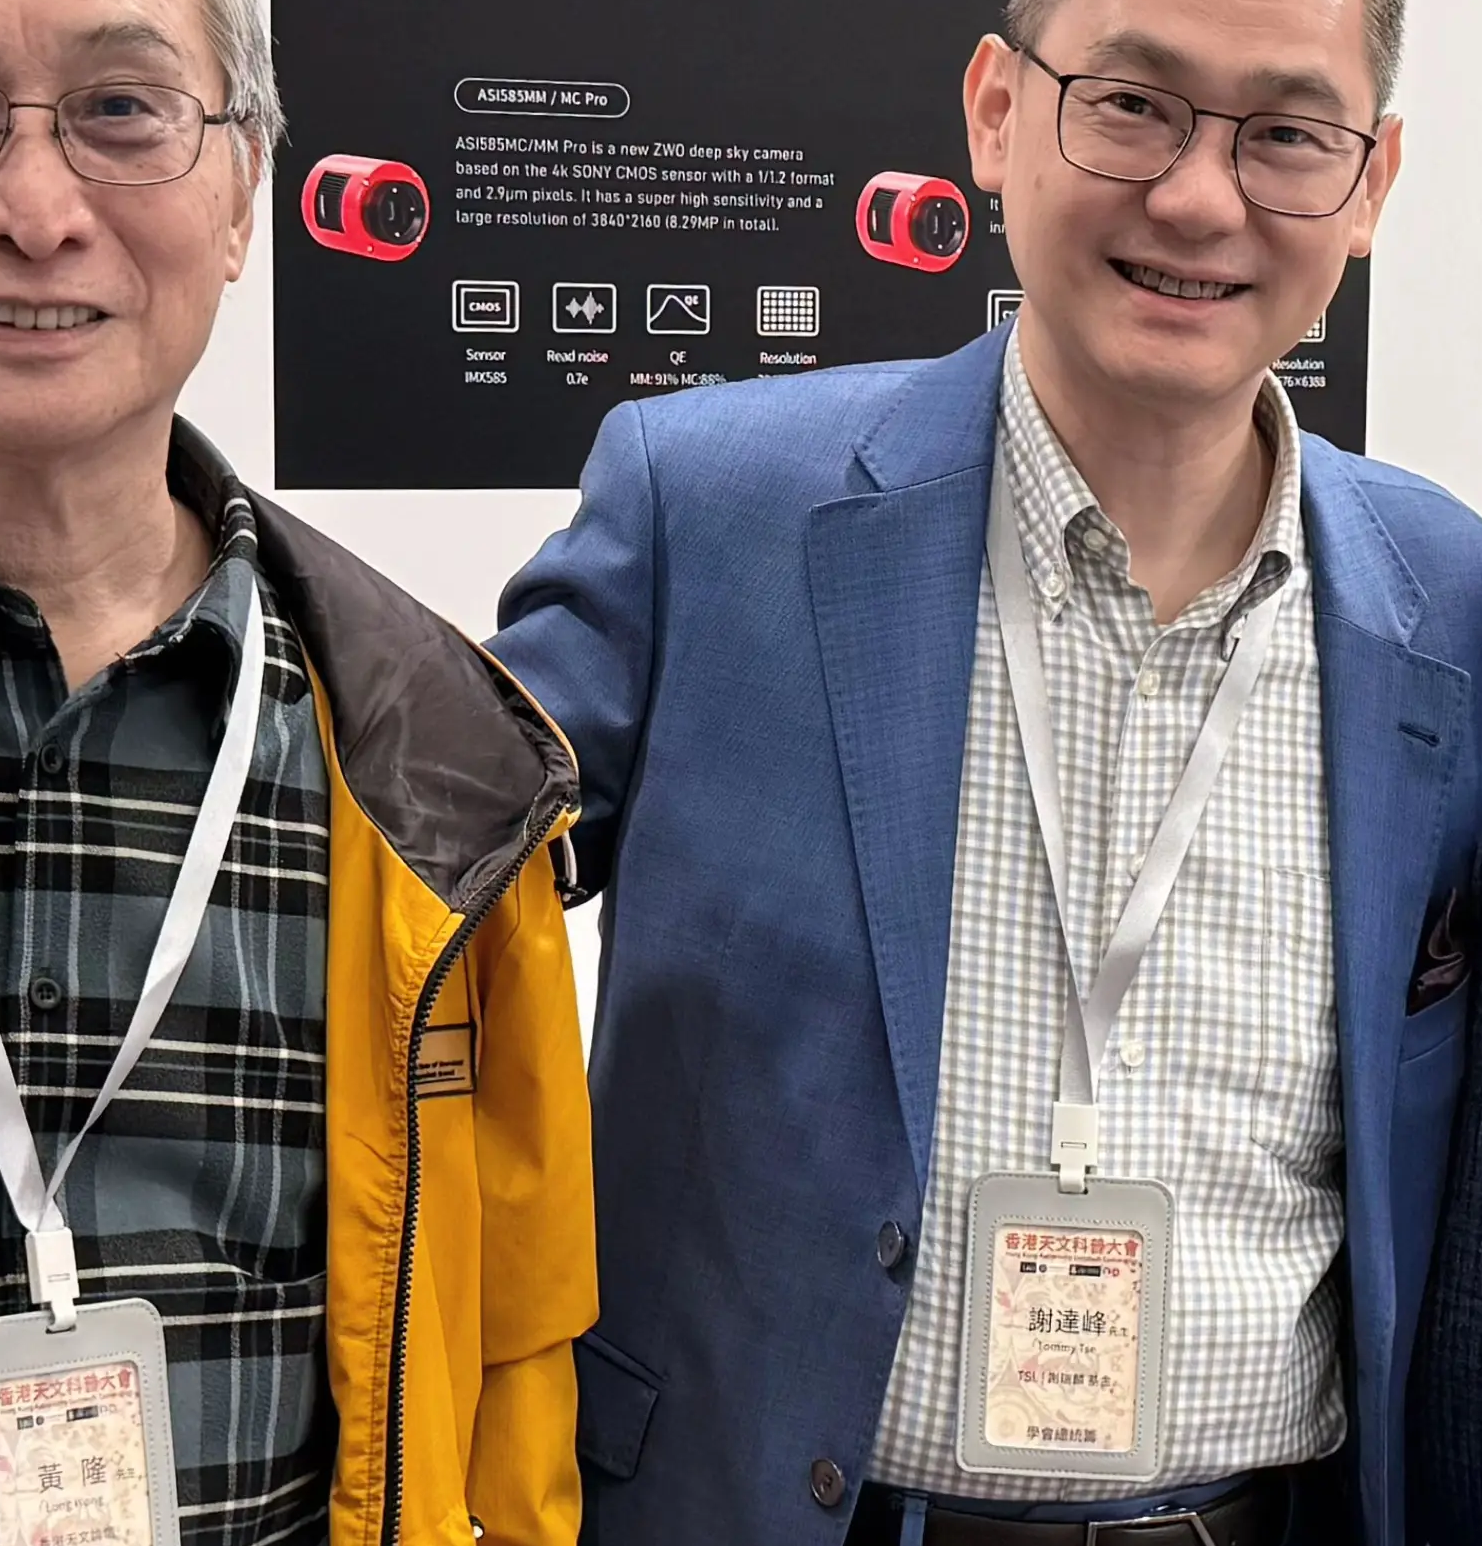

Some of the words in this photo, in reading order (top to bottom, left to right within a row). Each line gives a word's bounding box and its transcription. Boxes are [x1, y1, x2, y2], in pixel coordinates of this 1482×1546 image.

[478, 89, 546, 103] ASI585MM
[561, 92, 580, 105] MC
[586, 92, 607, 106] Pro
[456, 136, 558, 152] ASI585MC/MM
[564, 140, 587, 154] Pro
[621, 145, 649, 155] new
[653, 143, 684, 157] ZWO
[689, 145, 721, 160] deep
[727, 146, 749, 161] sky
[754, 149, 803, 160] camera
[456, 161, 498, 175] based
[525, 164, 547, 177] the
[573, 165, 611, 178] SONY
[616, 166, 657, 180] CMOS
[662, 170, 707, 181] sensor
[712, 170, 740, 182] with
[791, 172, 834, 185] format
[456, 187, 481, 199] and
[533, 188, 574, 203] pixels.
[596, 189, 620, 203] has
[638, 193, 675, 206] super
[681, 192, 708, 208] high
[714, 194, 783, 209] sensitivity
[456, 210, 492, 226] large
[497, 212, 567, 225] resolution
[666, 215, 718, 229] (8.29MP
[466, 349, 506, 360] Sensor
[1005, 1232, 1139, 1257] 香港天文科普大會
[1028, 1308, 1107, 1336] 謝達峰
